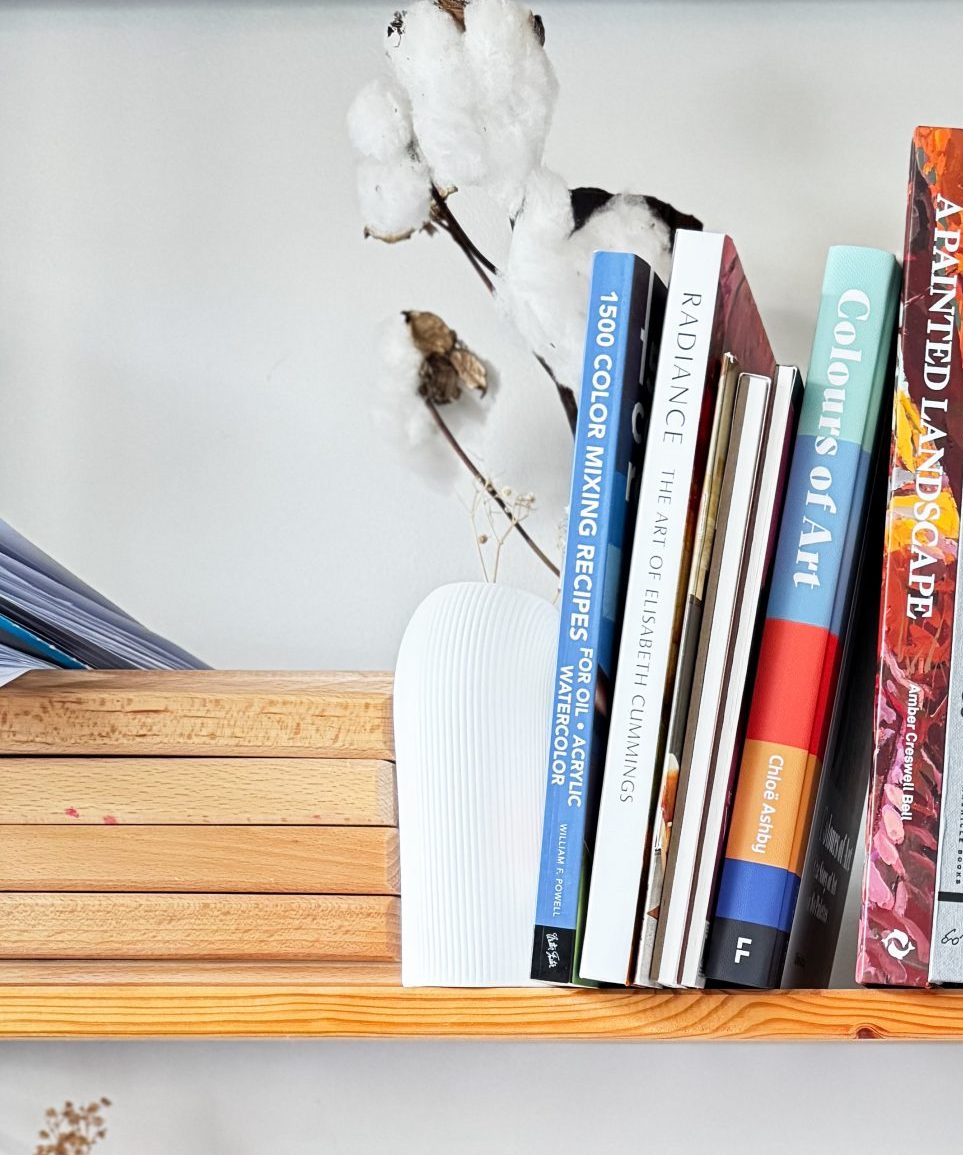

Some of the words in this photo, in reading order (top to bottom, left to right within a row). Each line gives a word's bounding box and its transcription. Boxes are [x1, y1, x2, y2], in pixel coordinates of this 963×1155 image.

[935, 193, 963, 221] A
[595, 290, 619, 348] 1500
[922, 227, 961, 391] PAINTED
[662, 292, 702, 445] RADIANCE
[814, 288, 872, 458] Colours
[587, 357, 614, 440] COLOR
[578, 446, 605, 538] MIXING
[657, 469, 676, 505] THE
[805, 465, 838, 515] of
[906, 397, 949, 620] LANDSCAPE
[651, 511, 669, 548] ART
[792, 515, 834, 590] Art
[569, 543, 596, 642] RECIPES
[647, 555, 664, 582] OF
[634, 588, 661, 687] ELISABETH
[578, 647, 595, 684] FOR
[550, 664, 576, 786] WATERCOLOR
[574, 687, 590, 718] OIL
[905, 683, 920, 731] Amber
[567, 733, 588, 808] ACRYLIC
[619, 694, 646, 804] CUMMINGS
[902, 732, 918, 793] Creswell
[761, 753, 785, 801] Chloë
[752, 804, 777, 855] Ashby
[900, 795, 914, 821] Bell
[556, 823, 568, 866] WILLIAM
[955, 849, 963, 885] BOOKS
[552, 877, 564, 917] POWELL
